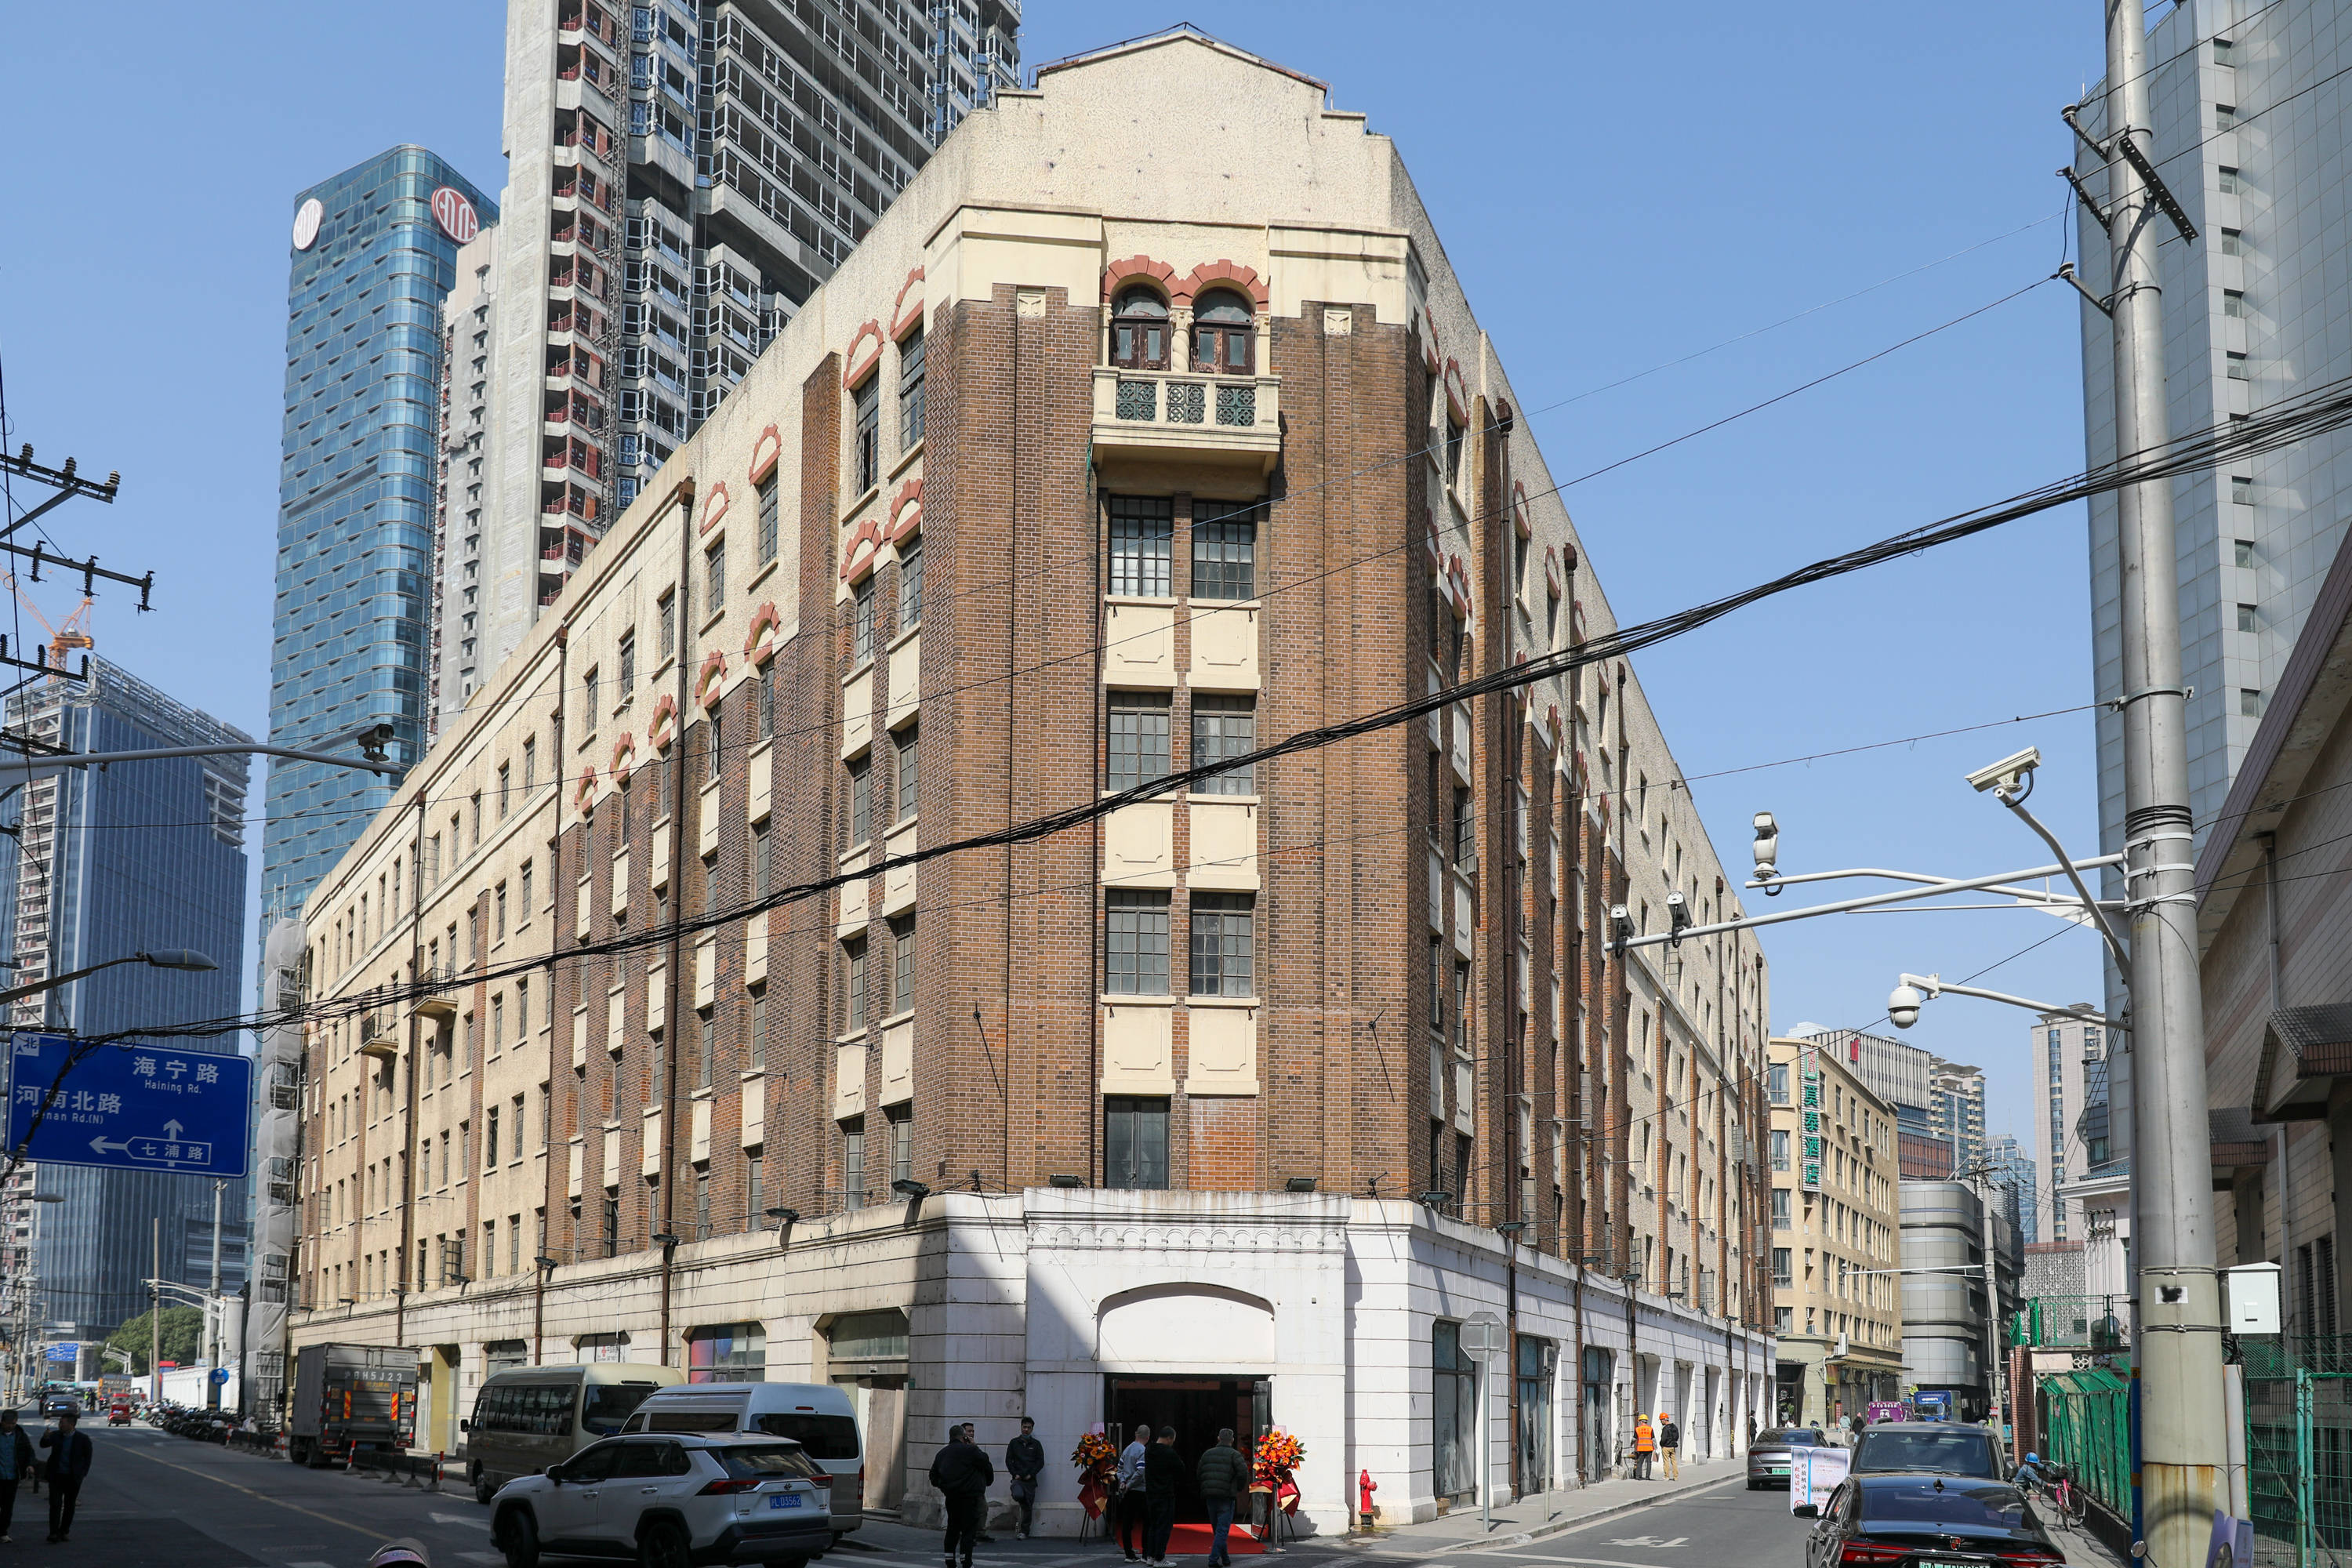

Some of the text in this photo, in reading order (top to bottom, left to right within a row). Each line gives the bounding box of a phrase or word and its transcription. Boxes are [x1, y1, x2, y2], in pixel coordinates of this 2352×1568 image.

[24, 1036, 38, 1050] 北
[132, 1055, 220, 1084] 海宁路
[144, 1079, 202, 1094] Haining Rd.
[16, 1084, 122, 1115] 河南北路
[72, 1112, 104, 1125] Rd.(N)
[1805, 1084, 1820, 1185] 莫泰酒店
[141, 1142, 203, 1160] 七浦路
